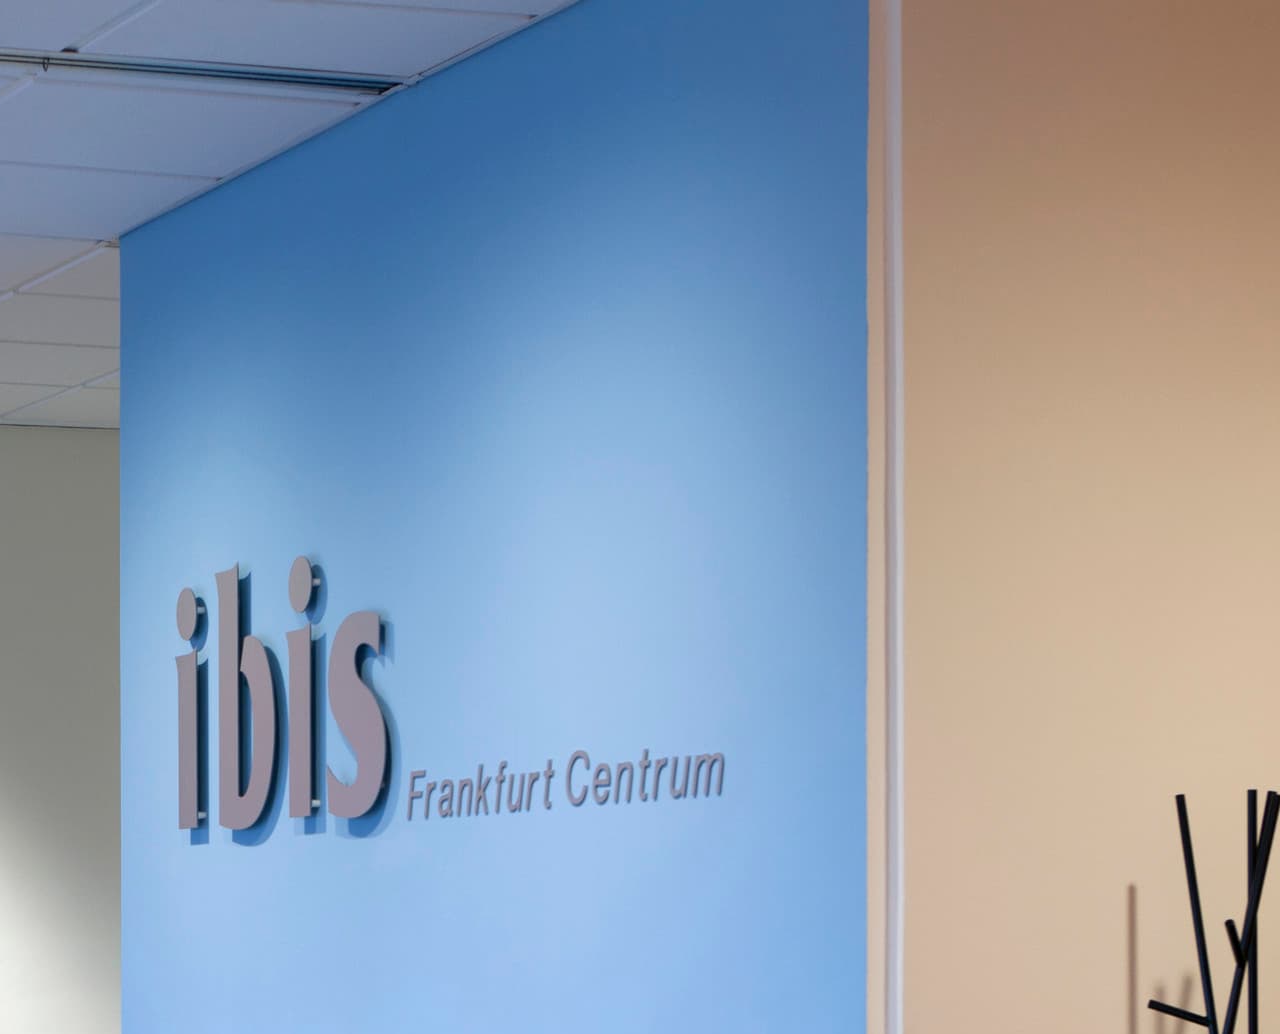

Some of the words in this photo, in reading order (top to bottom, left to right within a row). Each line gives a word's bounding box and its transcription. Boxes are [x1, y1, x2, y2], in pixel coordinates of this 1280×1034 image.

[175, 555, 390, 830] ibis
[407, 759, 554, 821] Frankfurt
[564, 748, 725, 806] Centrum
